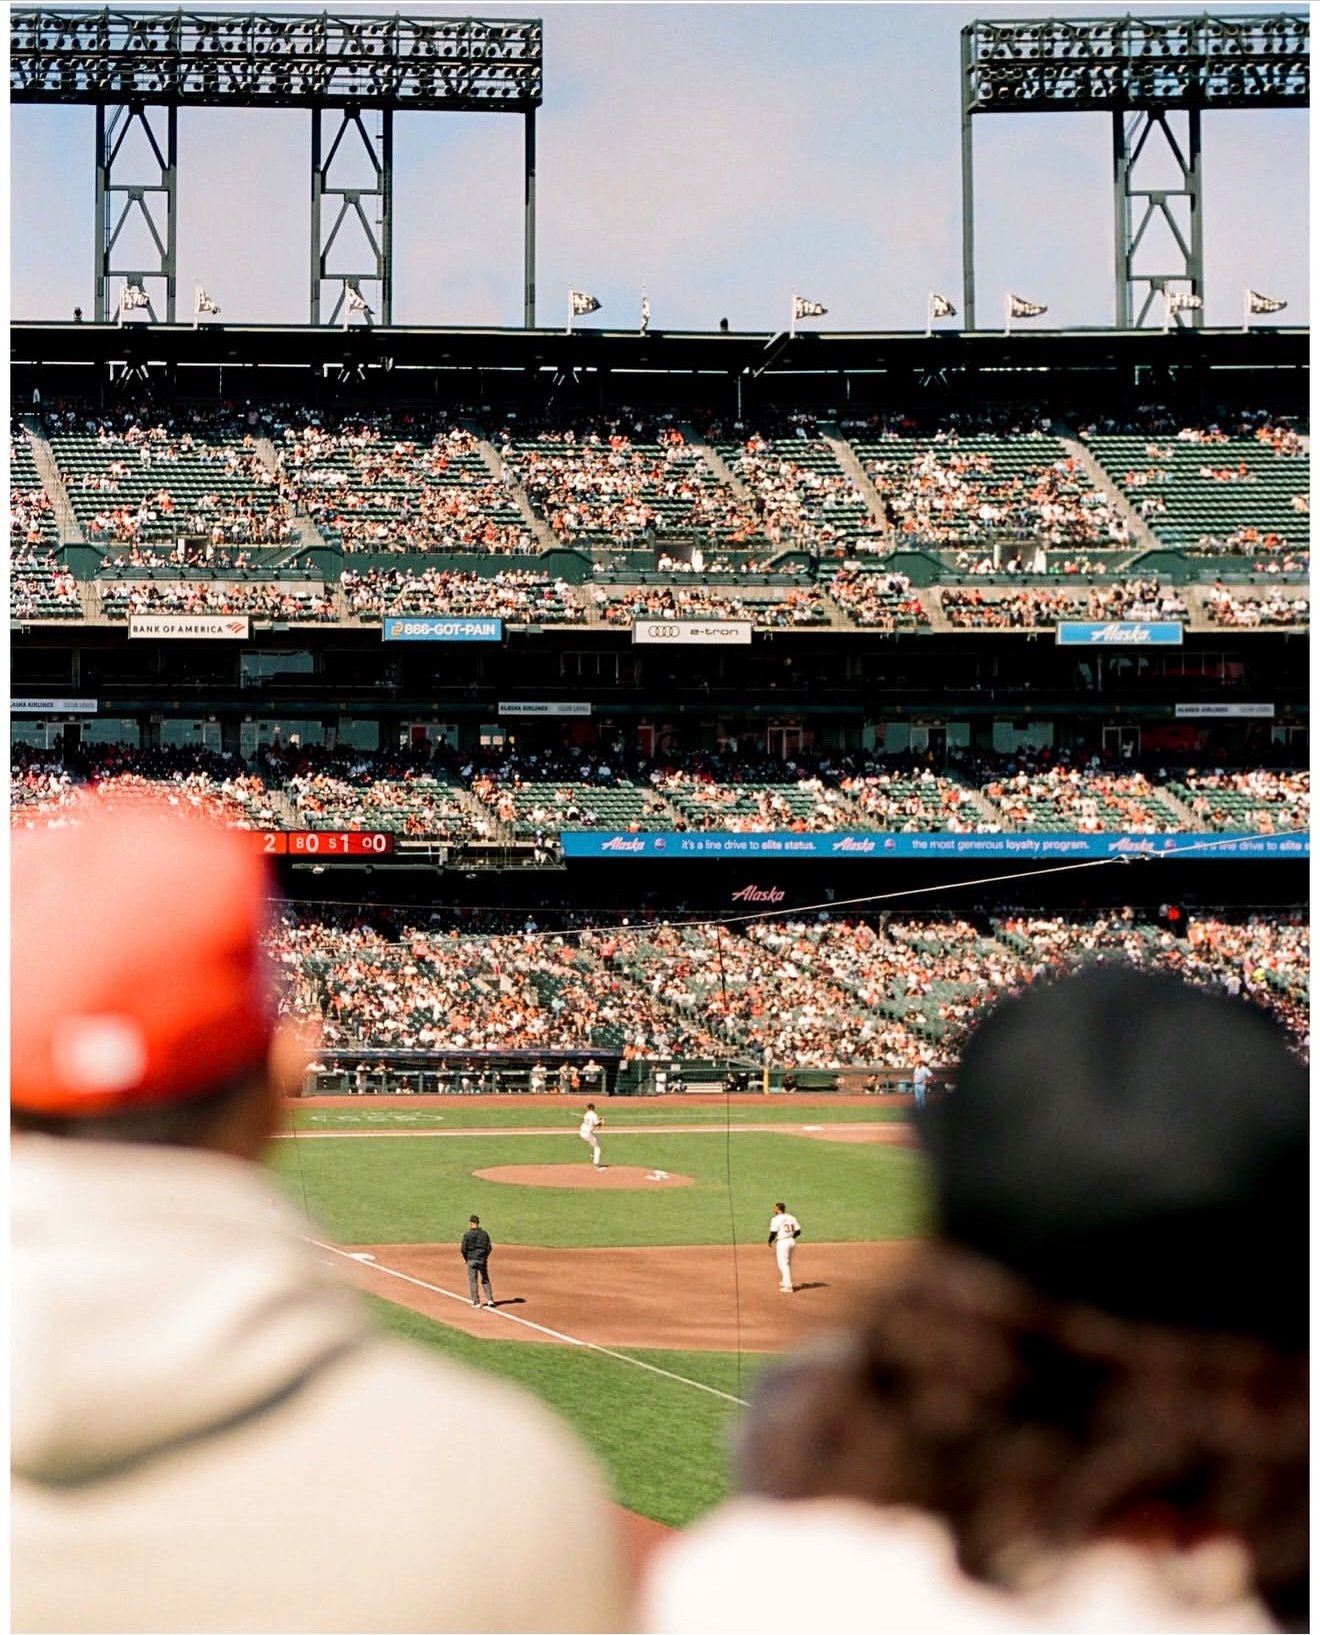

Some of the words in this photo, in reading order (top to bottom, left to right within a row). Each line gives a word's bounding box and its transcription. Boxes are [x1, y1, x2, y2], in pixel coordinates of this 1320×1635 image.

[133, 625, 160, 633] BANK
[162, 625, 175, 633] OF
[178, 625, 223, 633] AMERICA
[1090, 622, 1151, 642] Alaska
[264, 834, 277, 852] 2
[601, 837, 646, 851] Alaska
[682, 840, 695, 849] it's
[705, 840, 722, 849] line
[724, 840, 747, 849] drive
[750, 840, 760, 849] to
[762, 840, 782, 849] elite
[832, 837, 875, 852] Alaska
[912, 840, 928, 849] the
[930, 840, 954, 849] most
[957, 841, 1004, 851] generous
[1006, 840, 1040, 851] loyalty
[1239, 840, 1264, 850] drive
[1267, 840, 1277, 850] to
[1279, 840, 1302, 850] elite
[731, 884, 786, 903] Alaska
